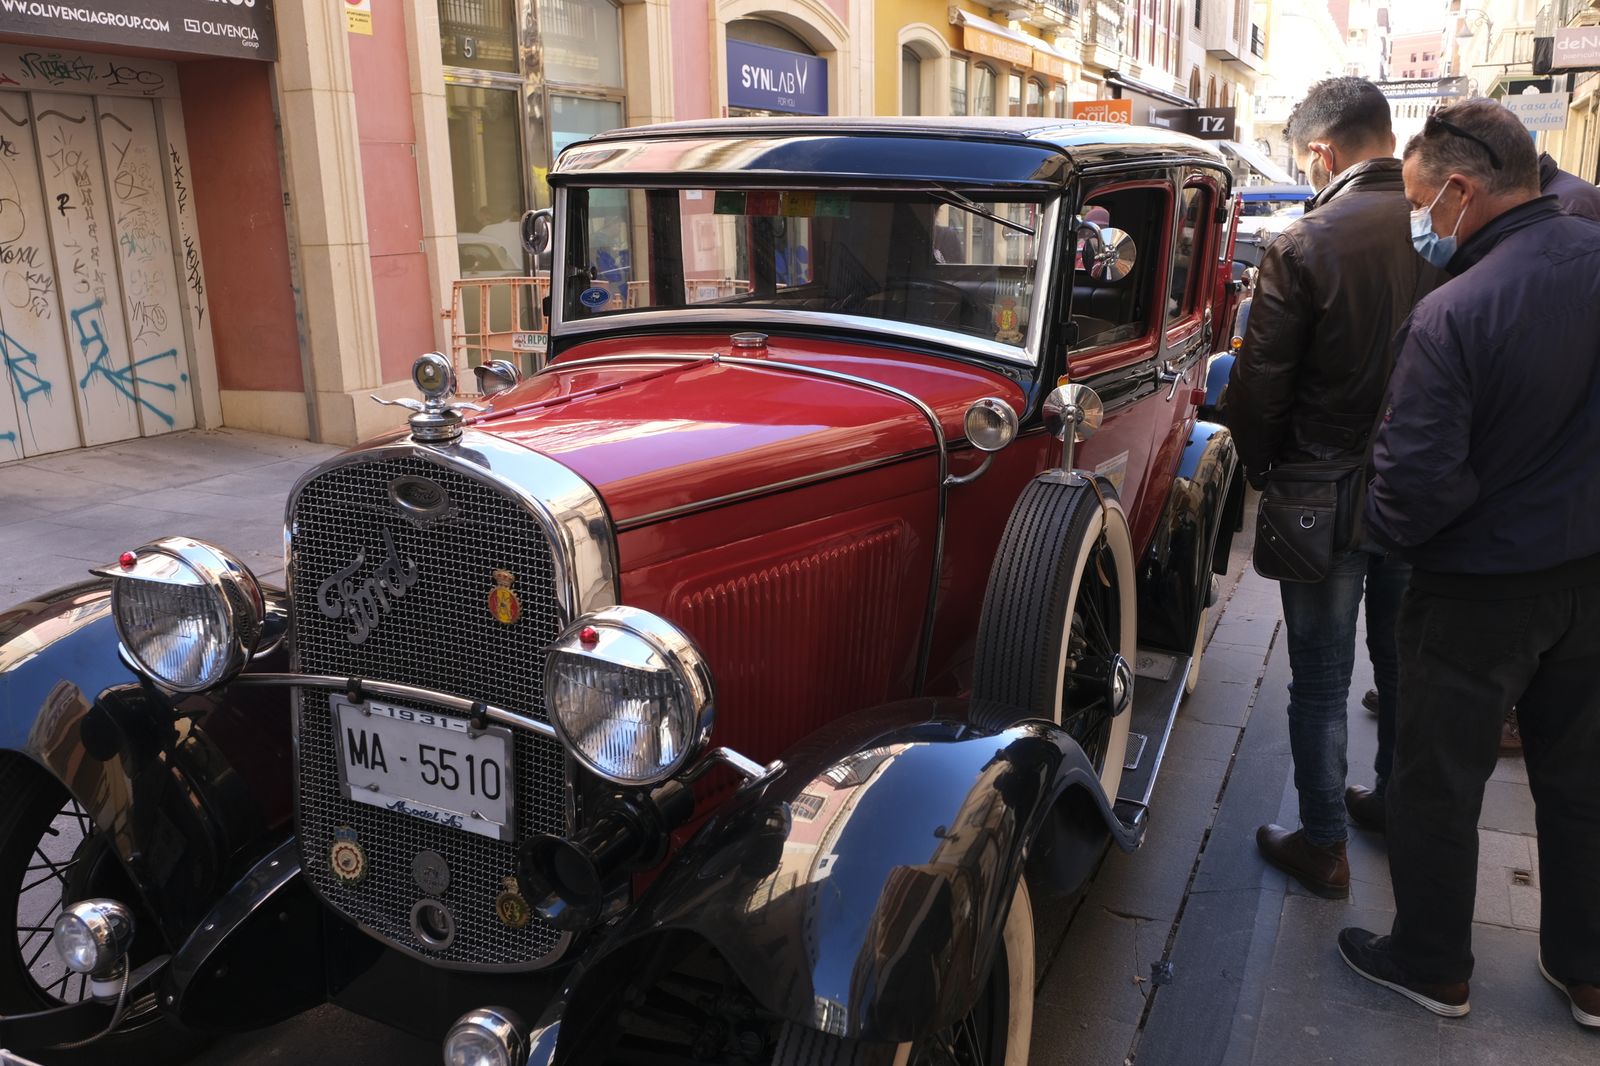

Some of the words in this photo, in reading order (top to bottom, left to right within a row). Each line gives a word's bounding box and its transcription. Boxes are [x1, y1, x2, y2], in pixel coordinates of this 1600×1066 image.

[201, 21, 259, 40] OLIVENCIA
[241, 39, 260, 48] Group
[463, 37, 473, 58] 5
[1556, 35, 1600, 50] deN
[742, 64, 795, 94] SYNLAB
[1076, 104, 1128, 123] carlos
[1549, 100, 1563, 109] de
[1198, 116, 1225, 132] TZ
[1523, 113, 1564, 124] medias
[317, 527, 419, 644] Ford
[347, 728, 388, 773] MA
[419, 744, 500, 800] 5510
[386, 800, 439, 821] Model
